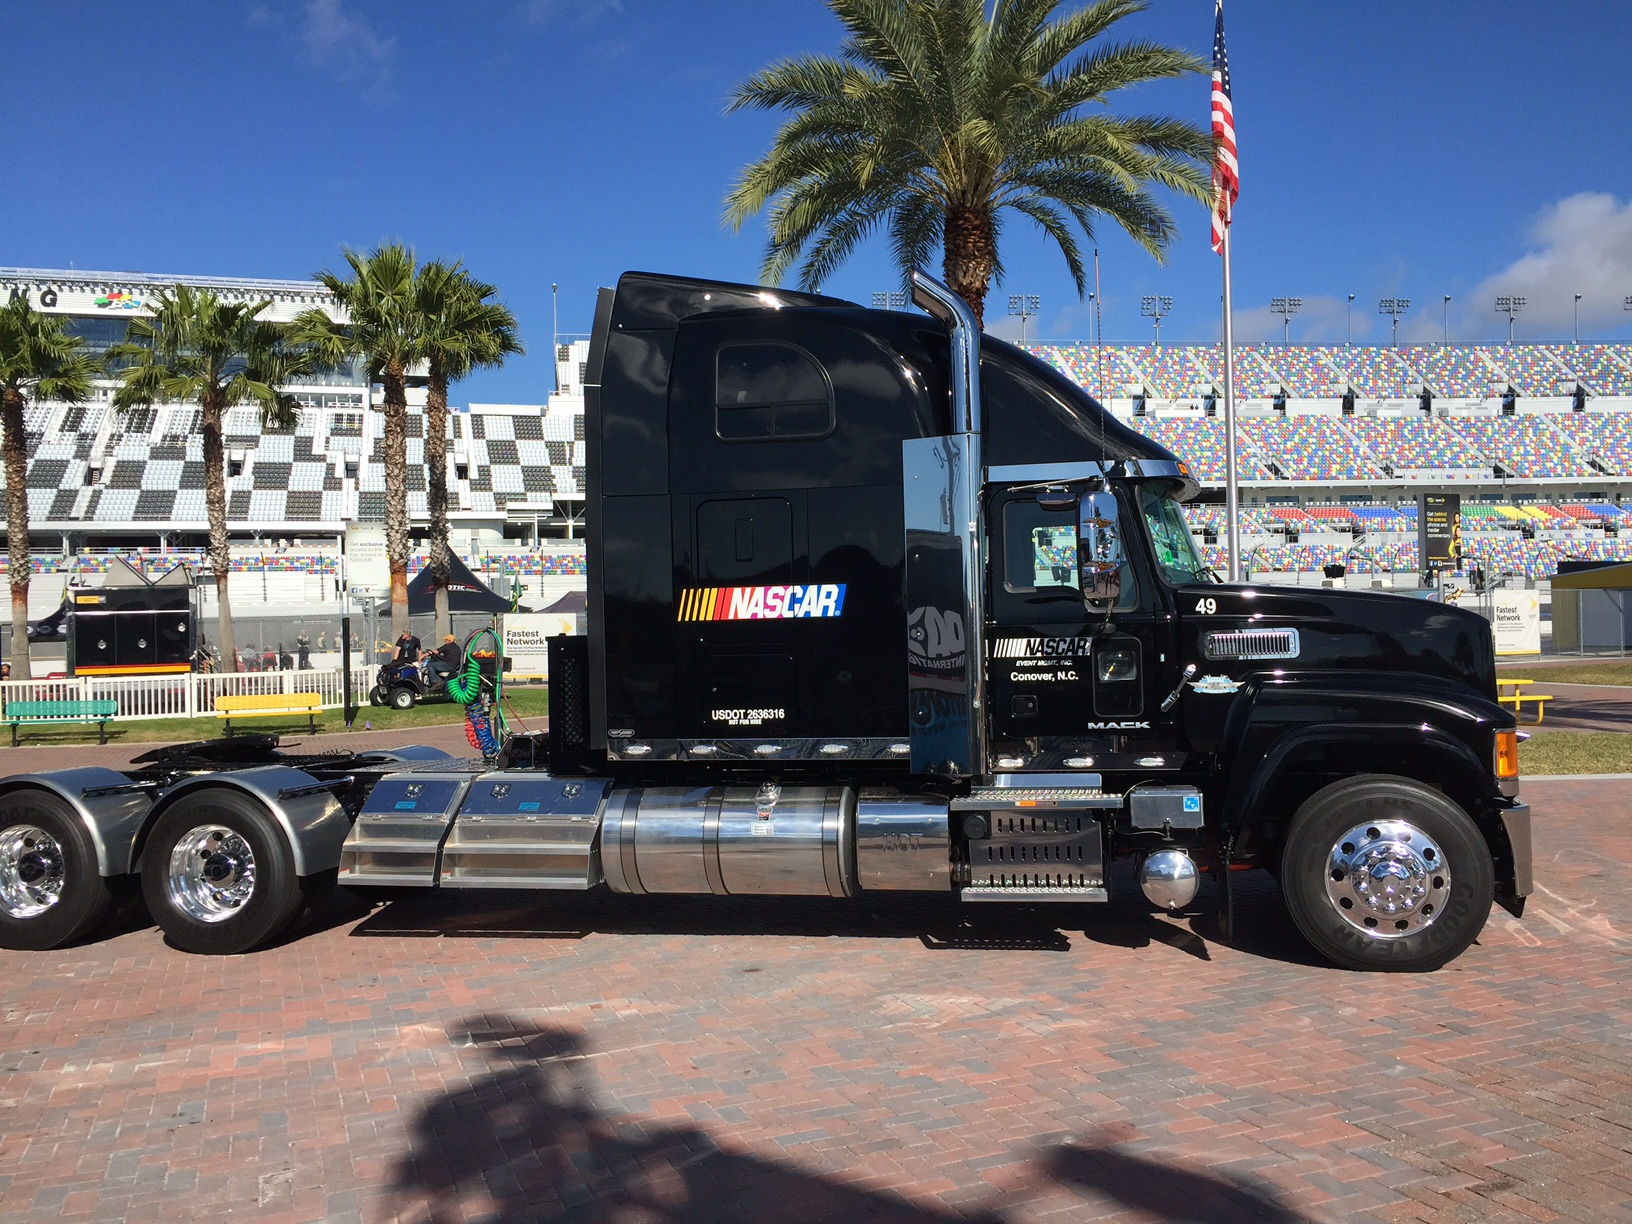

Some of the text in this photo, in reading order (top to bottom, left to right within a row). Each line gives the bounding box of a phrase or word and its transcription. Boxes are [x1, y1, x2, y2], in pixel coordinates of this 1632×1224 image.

[727, 584, 840, 619] NASCAR
[1195, 597, 1217, 615] 49
[1496, 605, 1517, 614] Fastest
[506, 630, 539, 638] Fastest
[506, 637, 545, 645] Network
[1024, 637, 1089, 656] NASCAR
[1010, 671, 1079, 682] Conover, N.C.
[711, 708, 785, 720] USDOT 2636316
[1087, 721, 1151, 730] MACK
[881, 831, 923, 852] HOT
